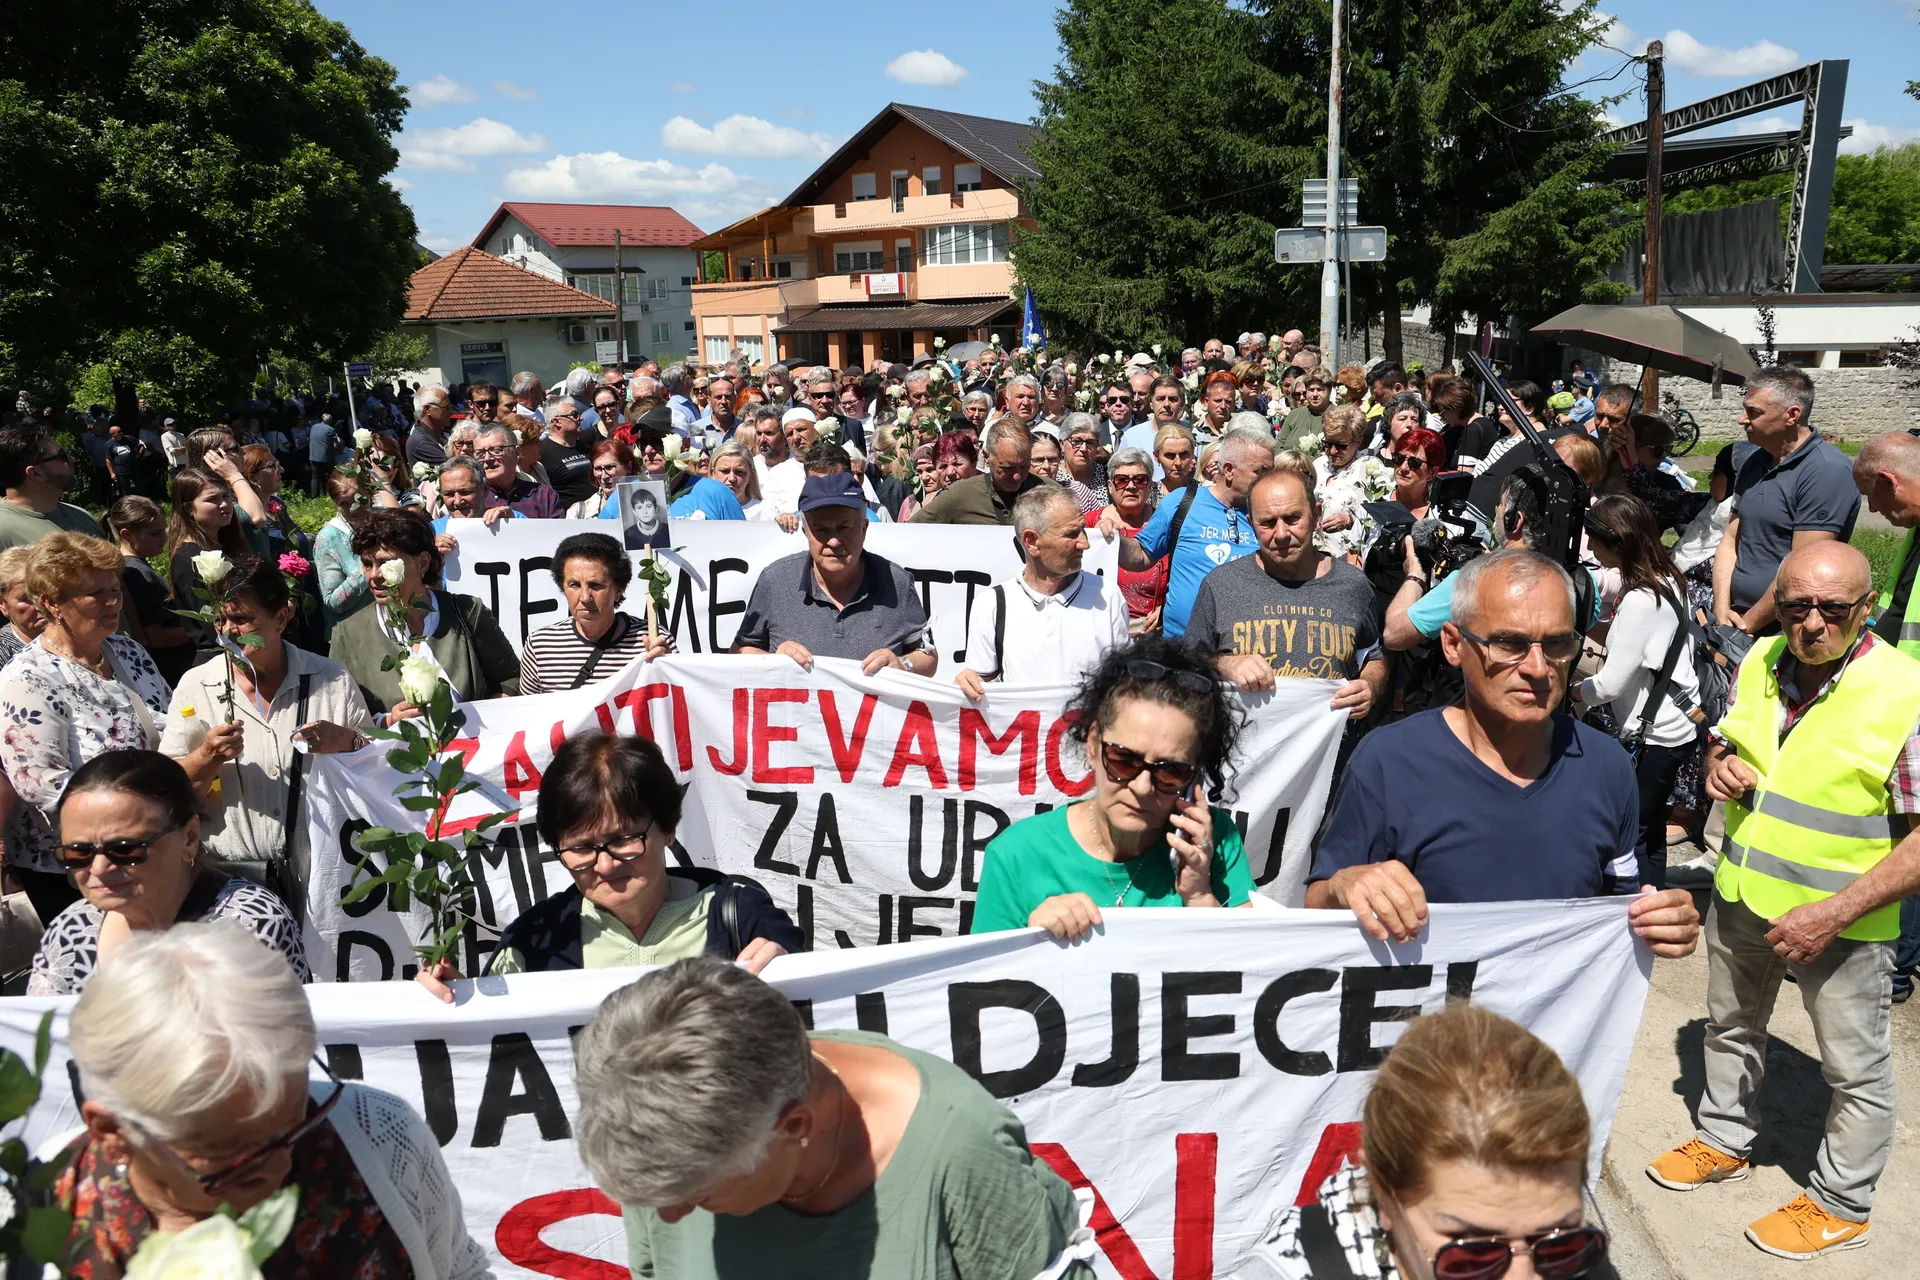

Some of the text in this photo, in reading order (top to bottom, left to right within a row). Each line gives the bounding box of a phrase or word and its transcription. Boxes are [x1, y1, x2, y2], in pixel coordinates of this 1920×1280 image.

[1200, 526, 1219, 539] JER
[1238, 532, 1250, 544] SE
[1264, 605, 1332, 618] CLOTHING CO
[1232, 619, 1298, 656] SIXTY
[746, 790, 853, 885] ZA
